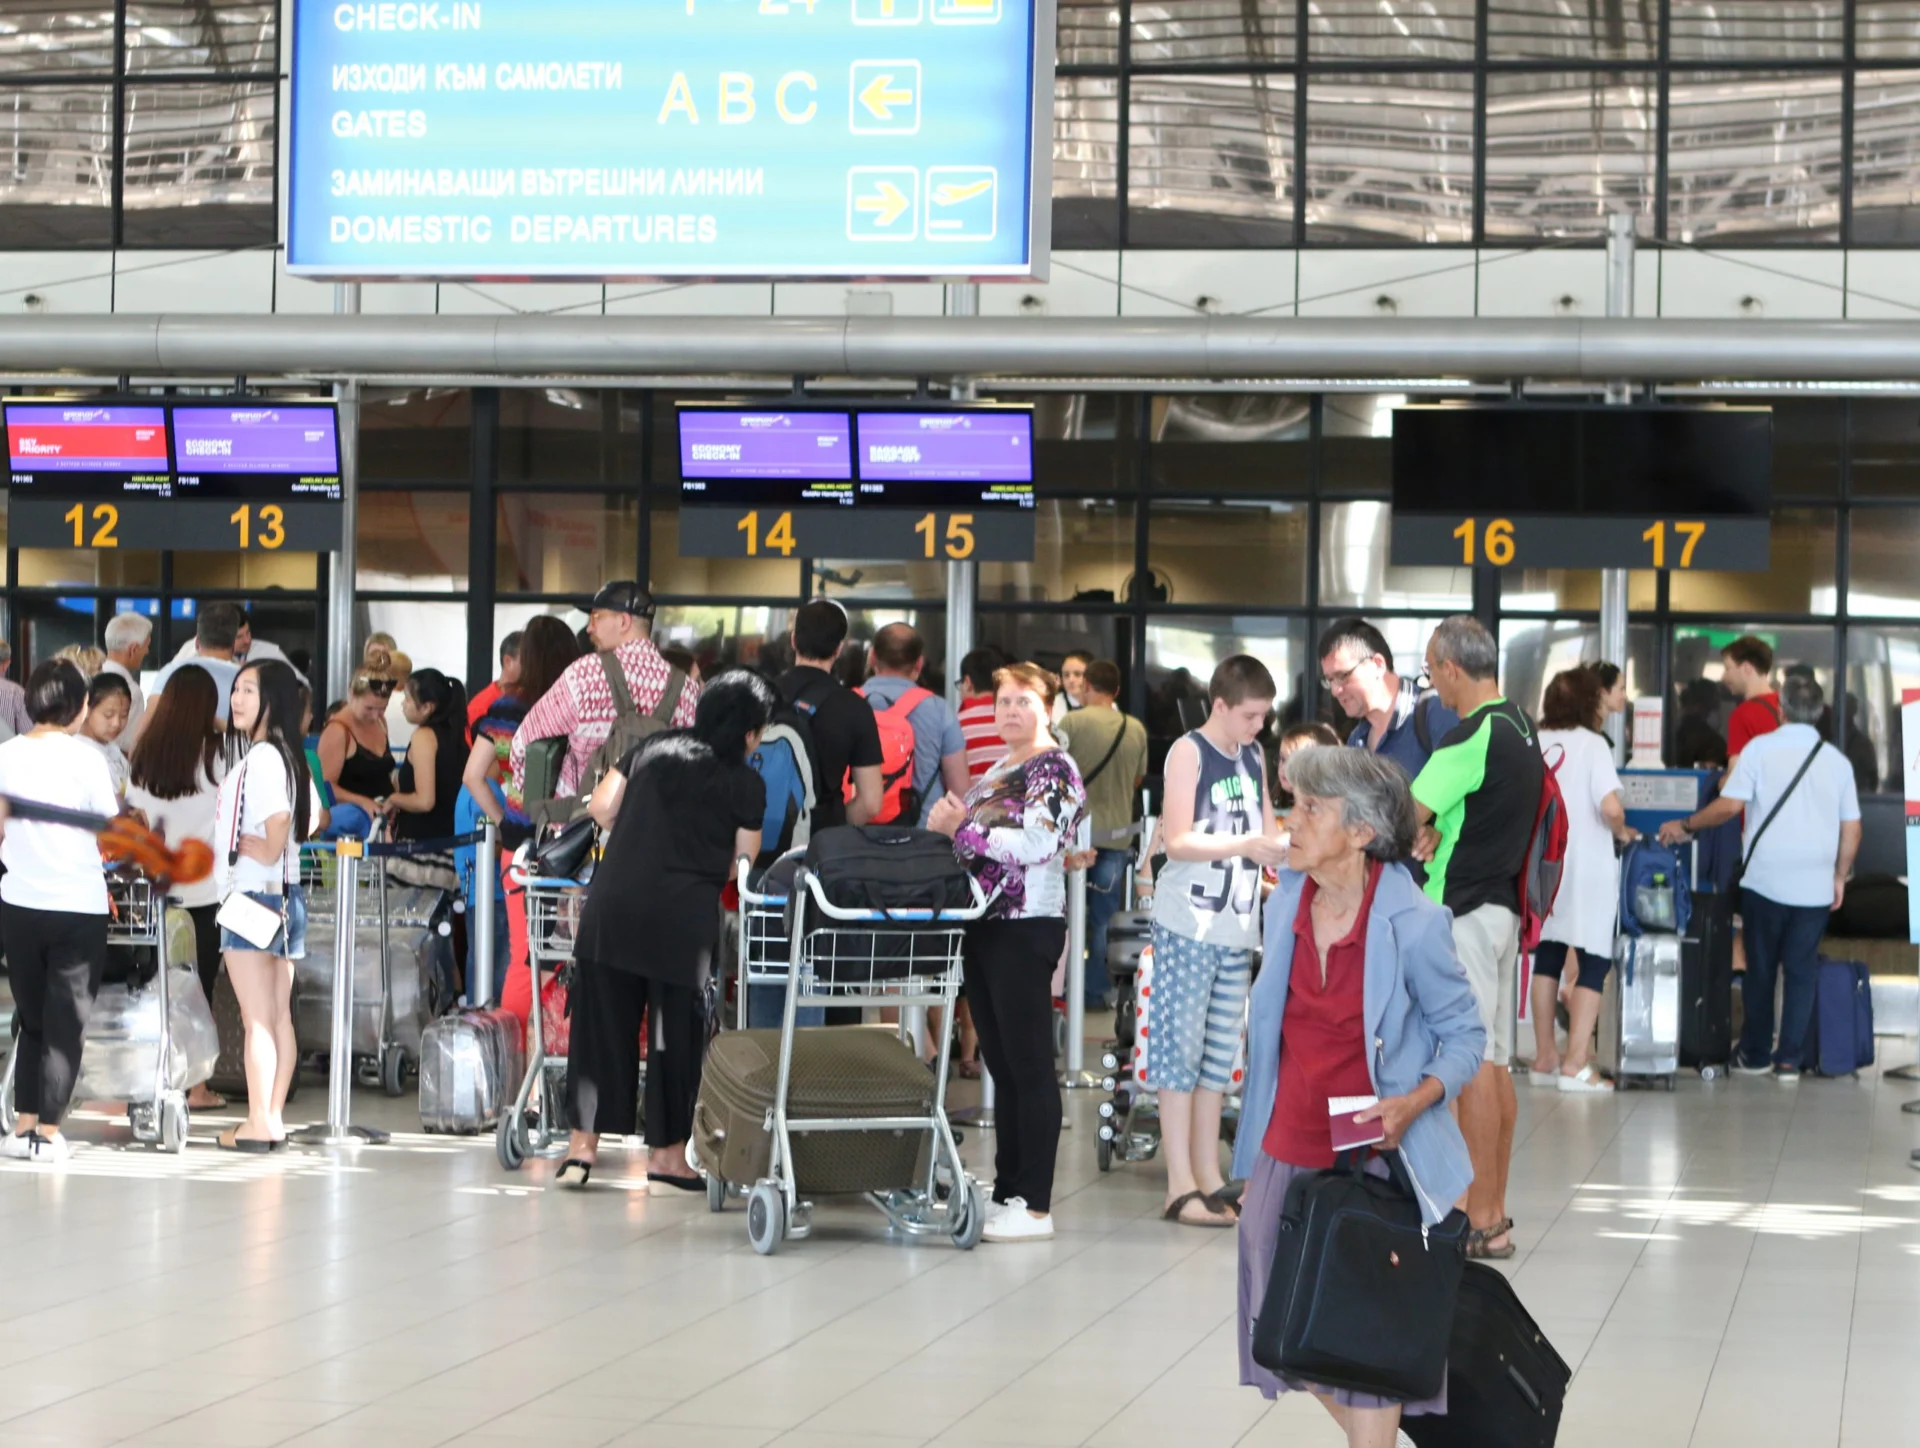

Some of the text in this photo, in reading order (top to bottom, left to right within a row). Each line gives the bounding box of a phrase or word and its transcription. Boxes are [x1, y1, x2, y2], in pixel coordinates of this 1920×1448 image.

[335, 3, 480, 30] CHECK-IN
[333, 62, 622, 93] ИЗХОДИ КЪМ САМОЛЕТИ
[658, 71, 817, 124] A B C
[332, 110, 427, 138] GATES
[332, 168, 763, 198] ЗАМИНАВАЩИ ВЪТРЕШНИ ЛИНИИ
[331, 216, 716, 243] DOMESTIC DEPARTURES
[19, 446, 62, 454] PRIORITY
[186, 439, 232, 448] ECONOMY
[186, 448, 232, 456] CHECK-IN
[692, 444, 742, 452] ECONOMY
[692, 452, 740, 460] CHECK-IN
[65, 503, 118, 547] 12
[231, 505, 285, 548] 13
[738, 511, 796, 556] 14
[916, 513, 974, 558] 15
[1454, 518, 1515, 565] 16
[1643, 521, 1705, 568] 17
